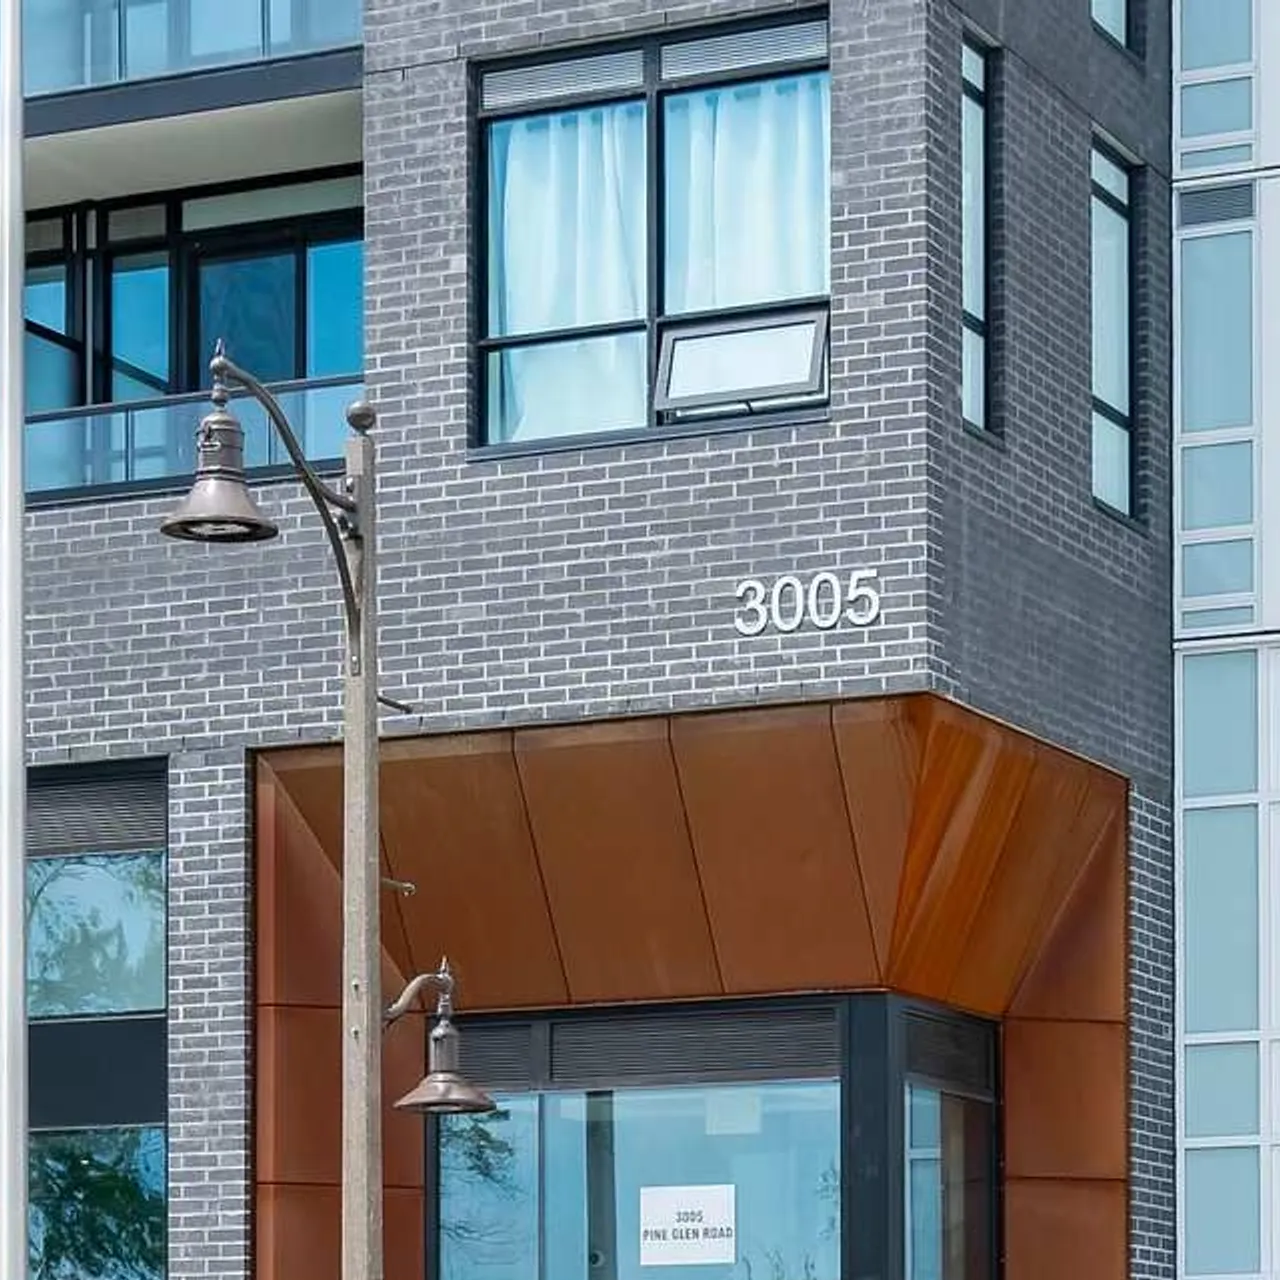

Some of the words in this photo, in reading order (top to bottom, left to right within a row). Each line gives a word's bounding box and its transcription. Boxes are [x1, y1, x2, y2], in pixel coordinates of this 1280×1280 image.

[734, 569, 880, 637] 3005
[674, 1210, 704, 1223] 3005
[643, 1229, 667, 1241] PINE
[671, 1228, 699, 1240] GLEN
[703, 1226, 733, 1239] ROAD
